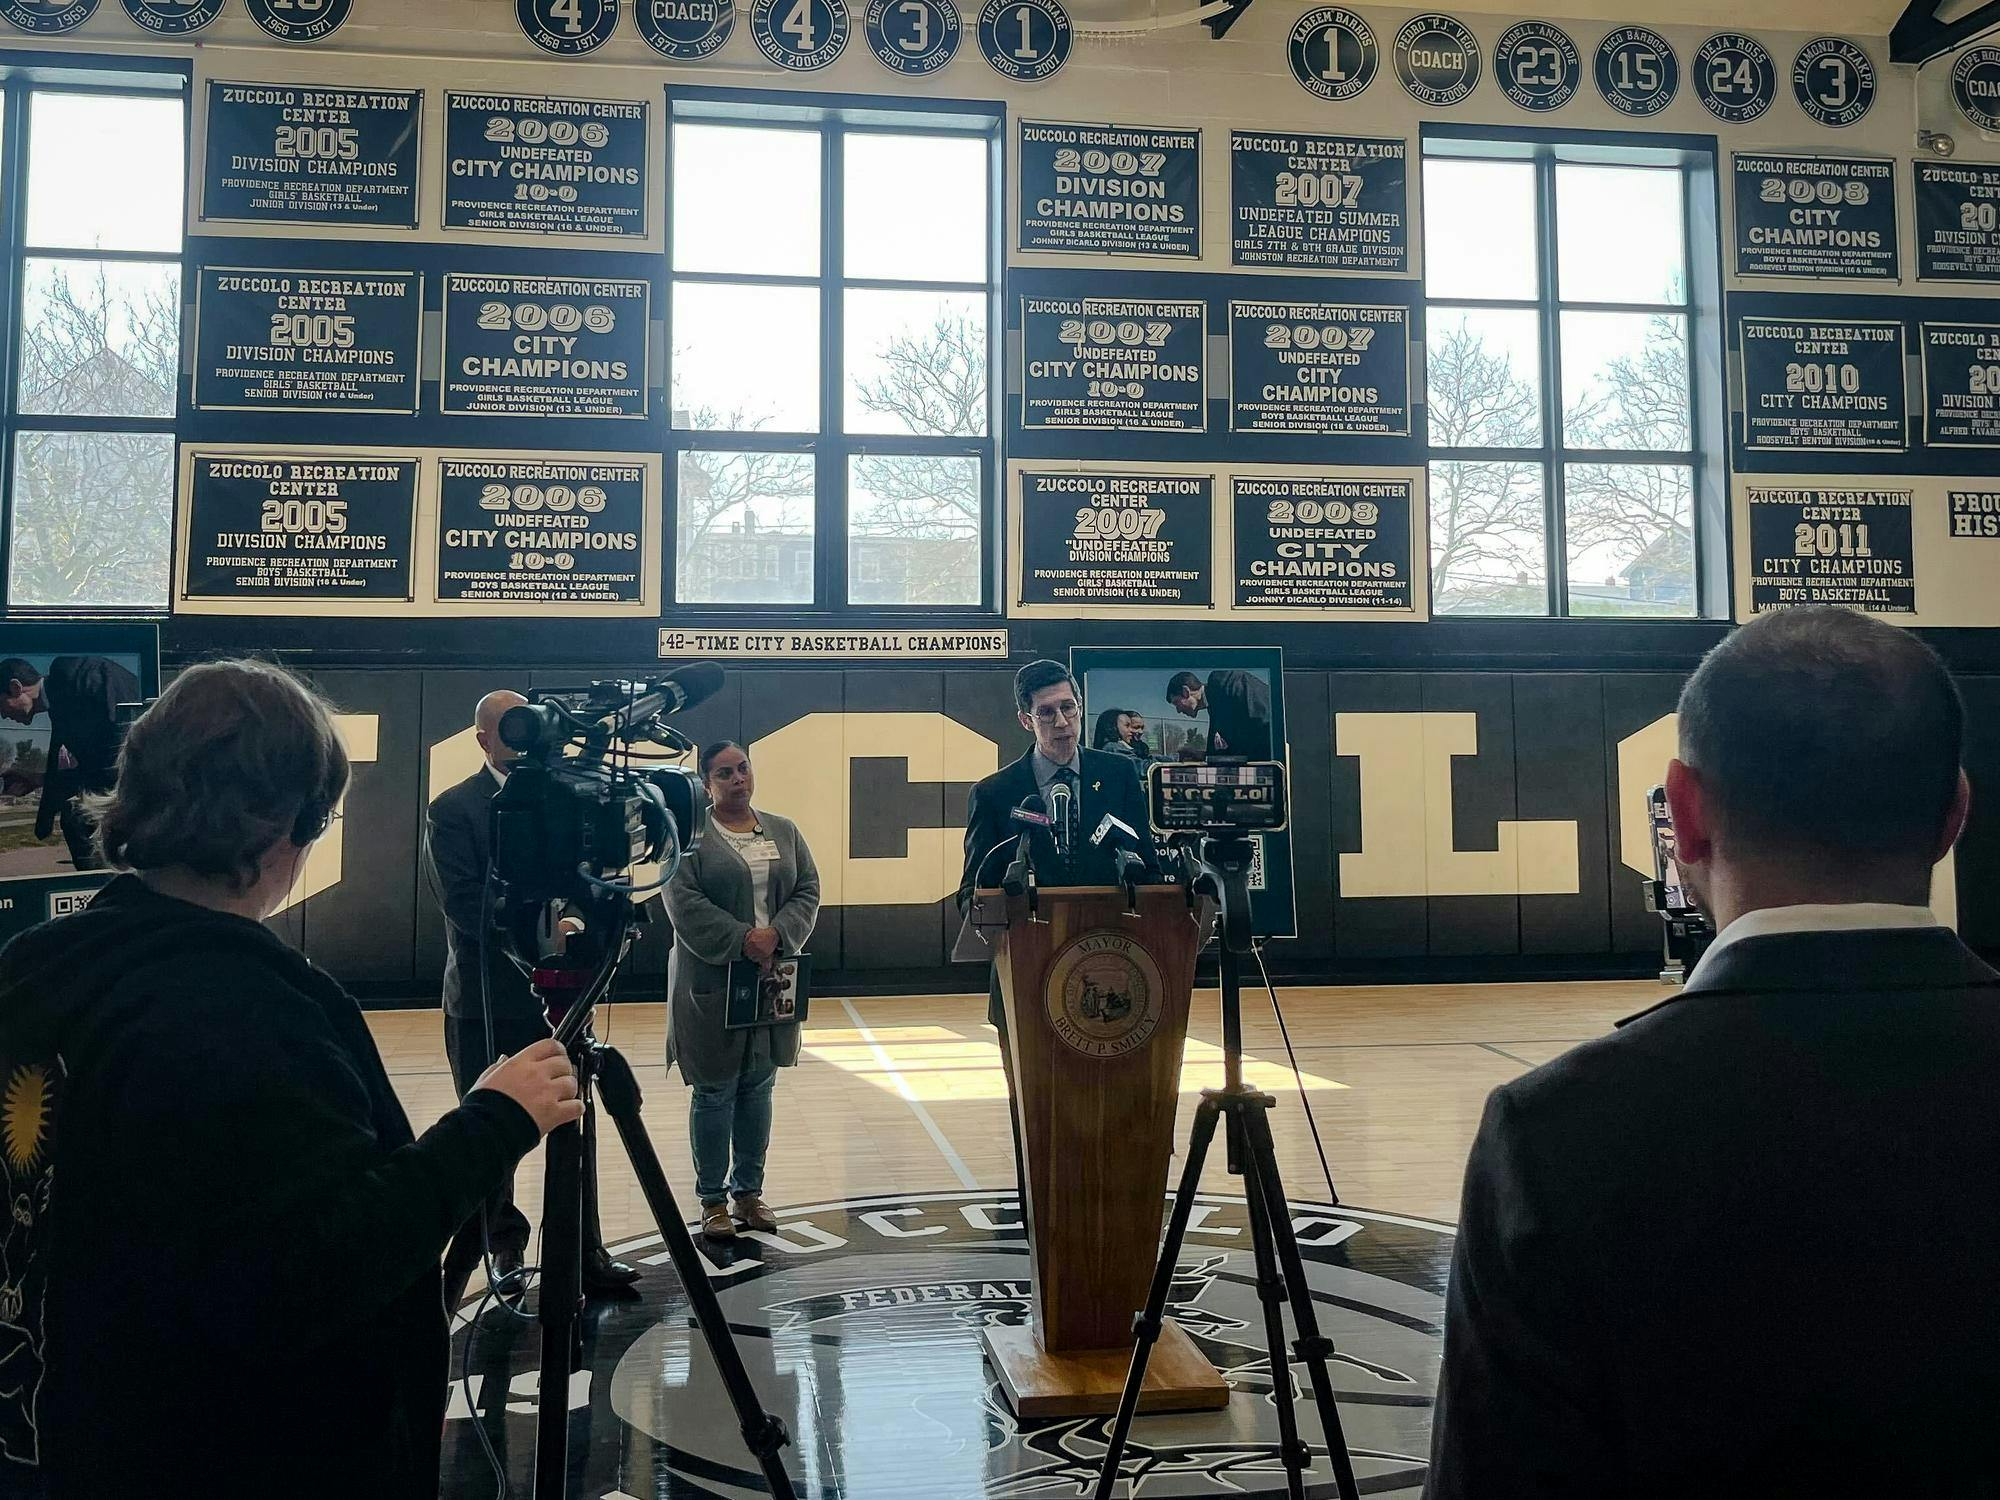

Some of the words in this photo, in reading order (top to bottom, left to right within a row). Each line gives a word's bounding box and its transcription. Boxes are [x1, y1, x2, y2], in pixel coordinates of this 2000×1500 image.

[5, 4, 35, 27] 1966
[57, 5, 87, 27] 1969
[550, 0, 581, 32] 4
[654, 2, 714, 21] COACH
[869, 1, 885, 24] ERIC
[937, 0, 958, 31] JONES
[306, 20, 332, 37] 1971
[782, 0, 814, 50] 4
[899, 3, 928, 51] 3
[1015, 8, 1037, 58] 1
[1294, 11, 1332, 43] KAREEM
[1336, 12, 1372, 47] BARROS
[1398, 22, 1426, 51] PEDRO
[1456, 28, 1476, 57] VEGA
[1602, 35, 1623, 54] NICO
[1627, 31, 1668, 59] BARBOSA
[1322, 28, 1345, 80] 1
[1412, 50, 1463, 70] COACH
[1700, 37, 1730, 60] DEJA
[1738, 38, 1767, 64] ROSS
[1517, 47, 1561, 85] 23
[1618, 52, 1657, 90] 15
[1794, 41, 1834, 84] DYAMOND
[1840, 45, 1872, 89] AZAKPO
[1712, 58, 1753, 94] 24
[1820, 58, 1846, 105] 3
[224, 89, 294, 105] ZUCCOLO
[303, 93, 409, 110] RECREATION
[452, 96, 510, 111] ZUCCOLO
[514, 99, 589, 116] RECREATION
[594, 104, 641, 119] CENTER
[283, 109, 350, 124] CENTER
[484, 116, 609, 148] 2006
[1024, 128, 1076, 142] ZUCCOLO
[1080, 132, 1148, 147] RECREATION
[1152, 135, 1194, 149] CENTER
[276, 126, 358, 160] 2005
[1232, 137, 1298, 154] ZUCCOLO
[1306, 141, 1404, 158] RECREATION
[500, 146, 592, 162] UNDEFEATED
[1053, 148, 1166, 176] 2007
[232, 156, 299, 173] DIVISION
[452, 159, 503, 177] CITY
[510, 162, 639, 184] CHAMPIONS
[1289, 157, 1350, 171] CENTER
[1737, 160, 1783, 173] ZUCCOLO
[1787, 162, 1848, 176] RECREATION
[1851, 166, 1890, 178] CENTER
[514, 183, 578, 202] 10-0
[1057, 176, 1165, 198] DIVISION
[1276, 172, 1363, 208] 2007
[1760, 178, 1869, 206] 2008
[1037, 199, 1184, 222] CHAMPIONS
[1239, 207, 1333, 224] UNDEFEATED
[1339, 212, 1400, 226] SUMMER
[1790, 209, 1840, 226] CITY
[1249, 224, 1302, 240] LEAGUE
[1310, 228, 1390, 243] CHAMPIONS
[1749, 227, 1881, 248] CHAMPIONS
[218, 277, 290, 293] ZUCCOLO
[298, 279, 406, 296] RECREATION
[452, 279, 509, 294] ZUCCOLO
[514, 281, 590, 296] RECREATION
[594, 284, 642, 298] CENTER
[278, 296, 346, 311] CENTER
[1028, 301, 1080, 315] ZUCCOLO
[1084, 303, 1153, 316] RECREATION
[1157, 305, 1199, 318] CENTER
[477, 302, 615, 333] 2006
[1235, 306, 1286, 319] ZUCCOLO
[1290, 308, 1357, 321] RECREATION
[1360, 310, 1402, 323] CENTER
[270, 313, 355, 348] 2005
[1058, 320, 1171, 346] 2007
[1264, 324, 1375, 350] 2007
[1747, 326, 1803, 340] ZUCCOLO
[1810, 328, 1894, 341] RECREATION
[514, 335, 577, 355] CITY
[1074, 347, 1156, 361] UNDEFEATED
[1795, 342, 1848, 354] CENTER
[226, 346, 295, 362] DIVISION
[303, 349, 394, 365] CHAMPIONS
[1279, 352, 1360, 365] UNDEFEATED
[463, 357, 628, 380] CHAMPIONS
[1030, 362, 1076, 378] CITY
[1083, 363, 1199, 382] CHAMPIONS
[1297, 368, 1342, 384] CITY
[1786, 363, 1859, 394] 2010
[1087, 381, 1144, 398] 10-0
[1263, 385, 1378, 403] CHAMPIONS
[1761, 394, 1794, 408] CITY
[1802, 396, 1887, 410] CHAMPIONS
[210, 463, 282, 479] ZUCCOLO
[291, 465, 400, 481] RECREATION
[447, 464, 506, 478] ZUCCOLO
[510, 466, 587, 480] RECREATION
[591, 468, 639, 482] CENTER
[270, 482, 338, 496] CENTER
[1037, 479, 1105, 493] ZUCCOLO
[1110, 480, 1199, 494] RECREATION
[1237, 483, 1289, 496] ZUCCOLO
[1292, 484, 1360, 497] RECREATION
[1363, 485, 1406, 497] CENTER
[479, 484, 606, 512] 2006
[1091, 495, 1148, 508] CENTER
[1750, 490, 1811, 504] ZUCCOLO
[1818, 492, 1910, 506] RECREATION
[261, 500, 347, 533] 2005
[495, 514, 589, 528] UNDEFEATED
[1267, 500, 1378, 526] 2008
[1803, 507, 1860, 520] CENTER
[1073, 508, 1166, 540] 2007
[217, 533, 287, 548] DIVISION
[295, 535, 386, 550] CHAMPIONS
[446, 530, 498, 547] CITY
[505, 531, 637, 550] CHAMPIONS
[1269, 528, 1376, 540] UNDEFEATED
[1795, 523, 1871, 557] 2011
[1066, 540, 1173, 551] "UNDEFEATED"
[1277, 543, 1368, 559] CITY
[509, 552, 574, 570] 10-0
[1070, 551, 1111, 561] DIVISION
[1114, 552, 1170, 562] CHAMPIONS
[1251, 561, 1396, 578] CHAMPIONS
[1764, 559, 1800, 574] CITY
[1810, 560, 1902, 575] CHAMPIONS
[445, 572, 506, 580] PROVIDENCE
[509, 573, 570, 581] RECREATION
[573, 574, 635, 582] DEPARTMENT
[501, 582, 567, 590] BASKETBALL
[570, 583, 609, 591] LEAGUE
[1106, 580, 1157, 588] BASKETBALL
[503, 591, 549, 599] DIVISION
[1780, 589, 1807, 600] BOYS
[1812, 589, 1889, 601] BASKETBALL
[666, 634, 739, 650] 42-TIME
[745, 636, 785, 650] CITY
[791, 636, 902, 651] BASKETBALL
[908, 636, 1001, 650] CHAMPIONS
[1079, 938, 1132, 954] MAYOR
[840, 1283, 1032, 1310] FEDERAL
